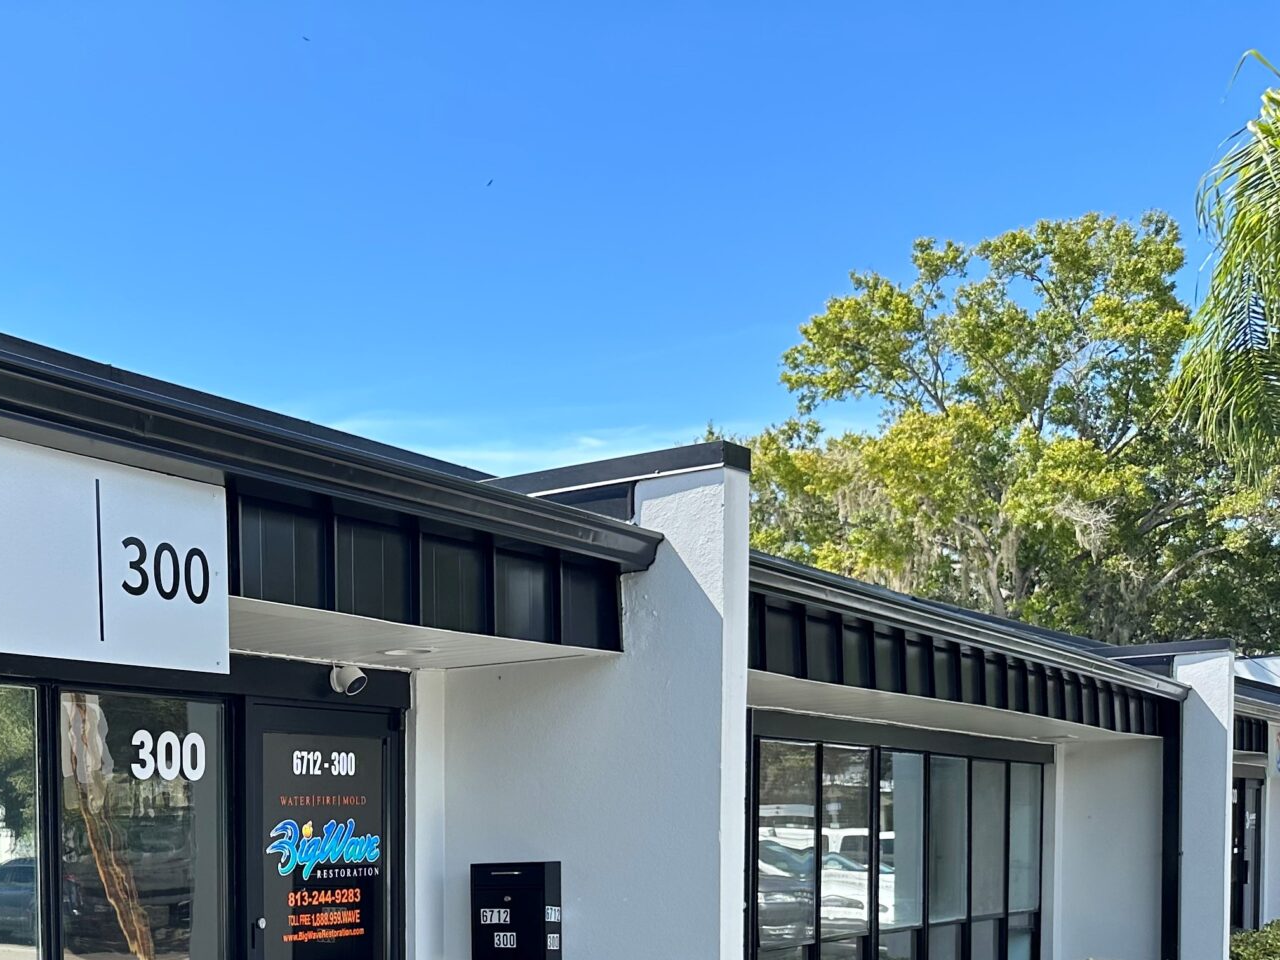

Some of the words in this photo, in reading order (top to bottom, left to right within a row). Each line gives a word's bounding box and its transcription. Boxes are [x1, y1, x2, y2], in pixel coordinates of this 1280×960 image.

[121, 536, 210, 605] 300
[130, 729, 206, 782] 300
[316, 867, 380, 879] RESTORATION
[288, 889, 361, 906] 813-244-9283
[481, 909, 509, 923] 6712
[495, 933, 516, 947] 300
